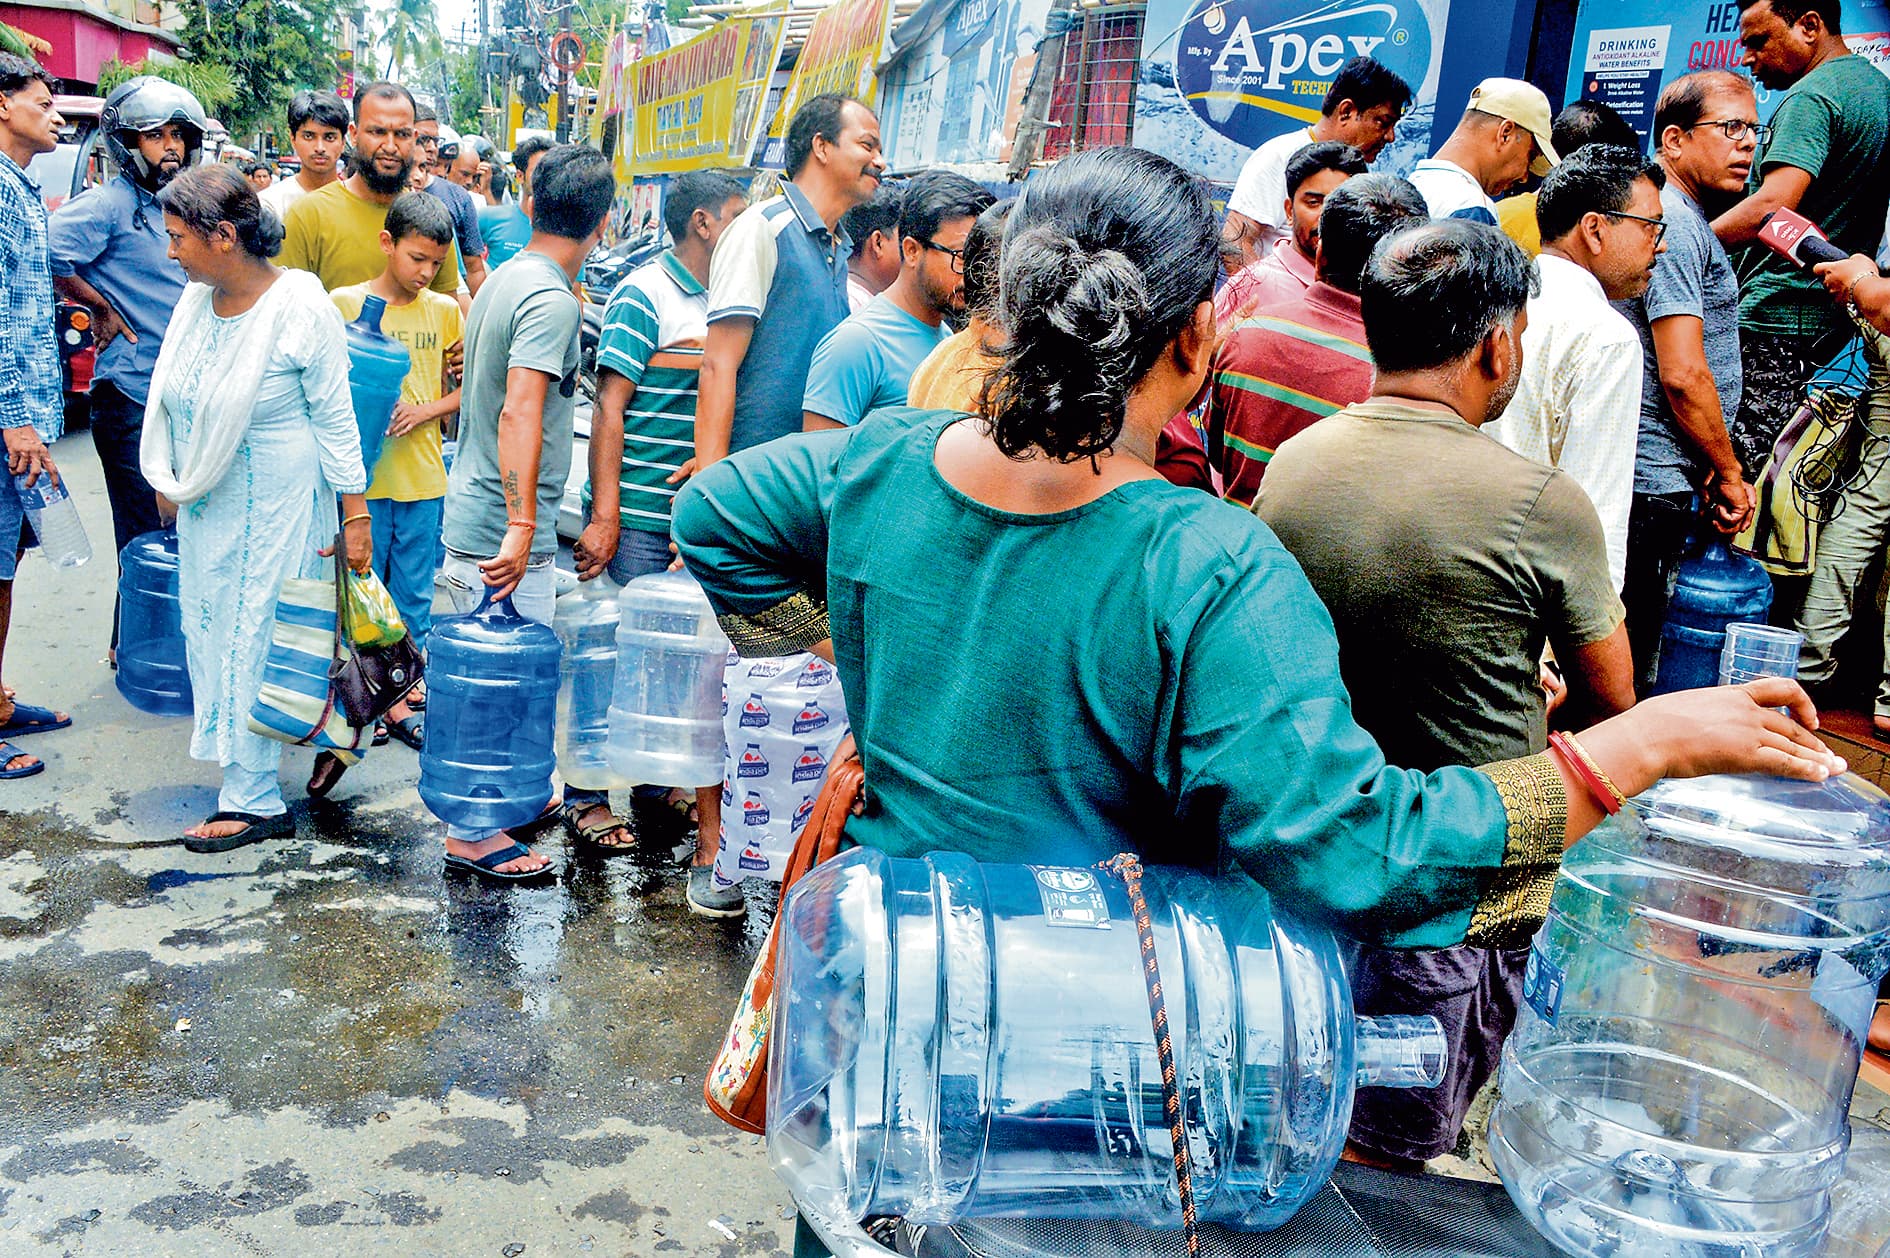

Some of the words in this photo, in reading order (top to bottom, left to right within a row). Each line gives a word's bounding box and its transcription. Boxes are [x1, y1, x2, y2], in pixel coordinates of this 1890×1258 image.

[1600, 38, 1657, 51] DRINKING
[1203, 47, 1212, 56] By
[1210, 16, 1386, 90] Apex
[1631, 50, 1660, 59] ALKALINE
[1599, 60, 1620, 69] WATER
[1620, 59, 1651, 67] BENEFITS
[1217, 74, 1241, 84] Since
[1242, 75, 1262, 85] 2001
[1608, 82, 1627, 90] Weight
